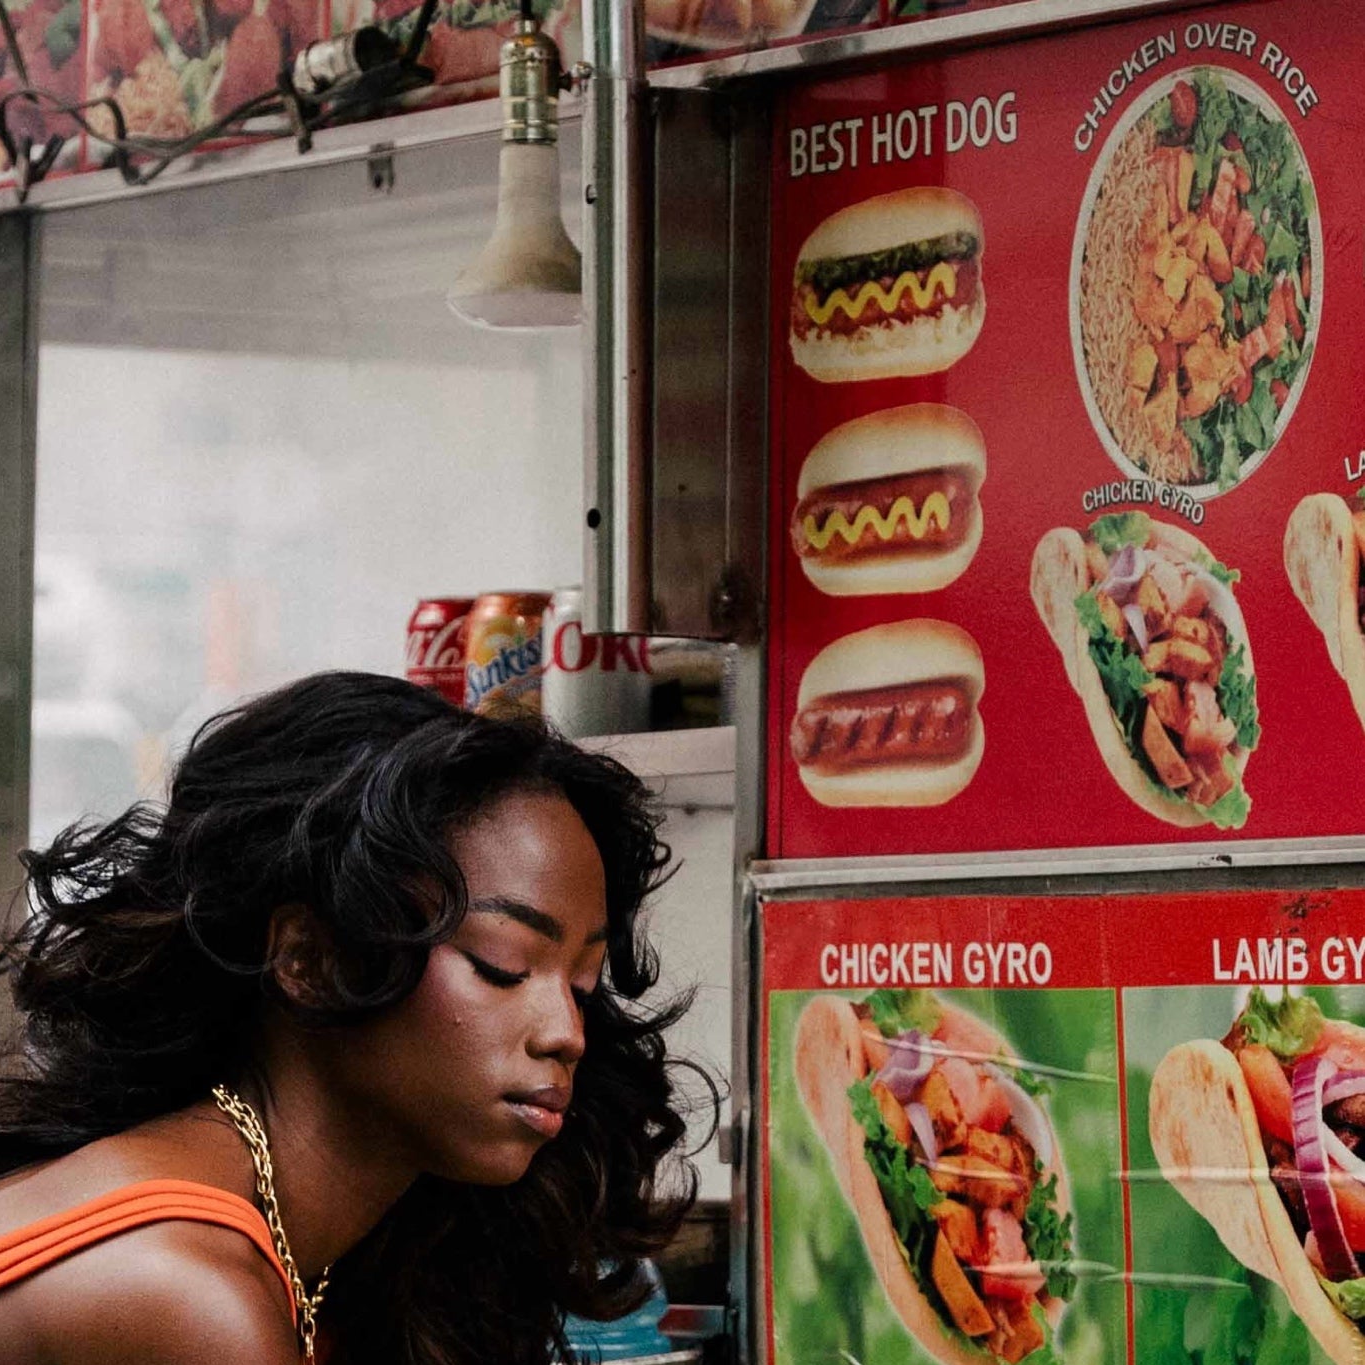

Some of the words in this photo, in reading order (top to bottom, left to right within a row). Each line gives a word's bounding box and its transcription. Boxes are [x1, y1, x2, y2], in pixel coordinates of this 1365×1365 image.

[1073, 30, 1176, 152] CHICKEN
[1184, 22, 1257, 57] OVER
[1259, 41, 1320, 117] RICE
[790, 118, 863, 177] BEST
[871, 105, 938, 164] HOT
[946, 91, 1017, 152] DOG
[1082, 479, 1157, 512] CHICKEN
[1158, 486, 1205, 525] GYRO
[820, 942, 953, 985] CHICKEN
[963, 941, 1052, 985] GYRO
[1212, 937, 1309, 981] LAMB
